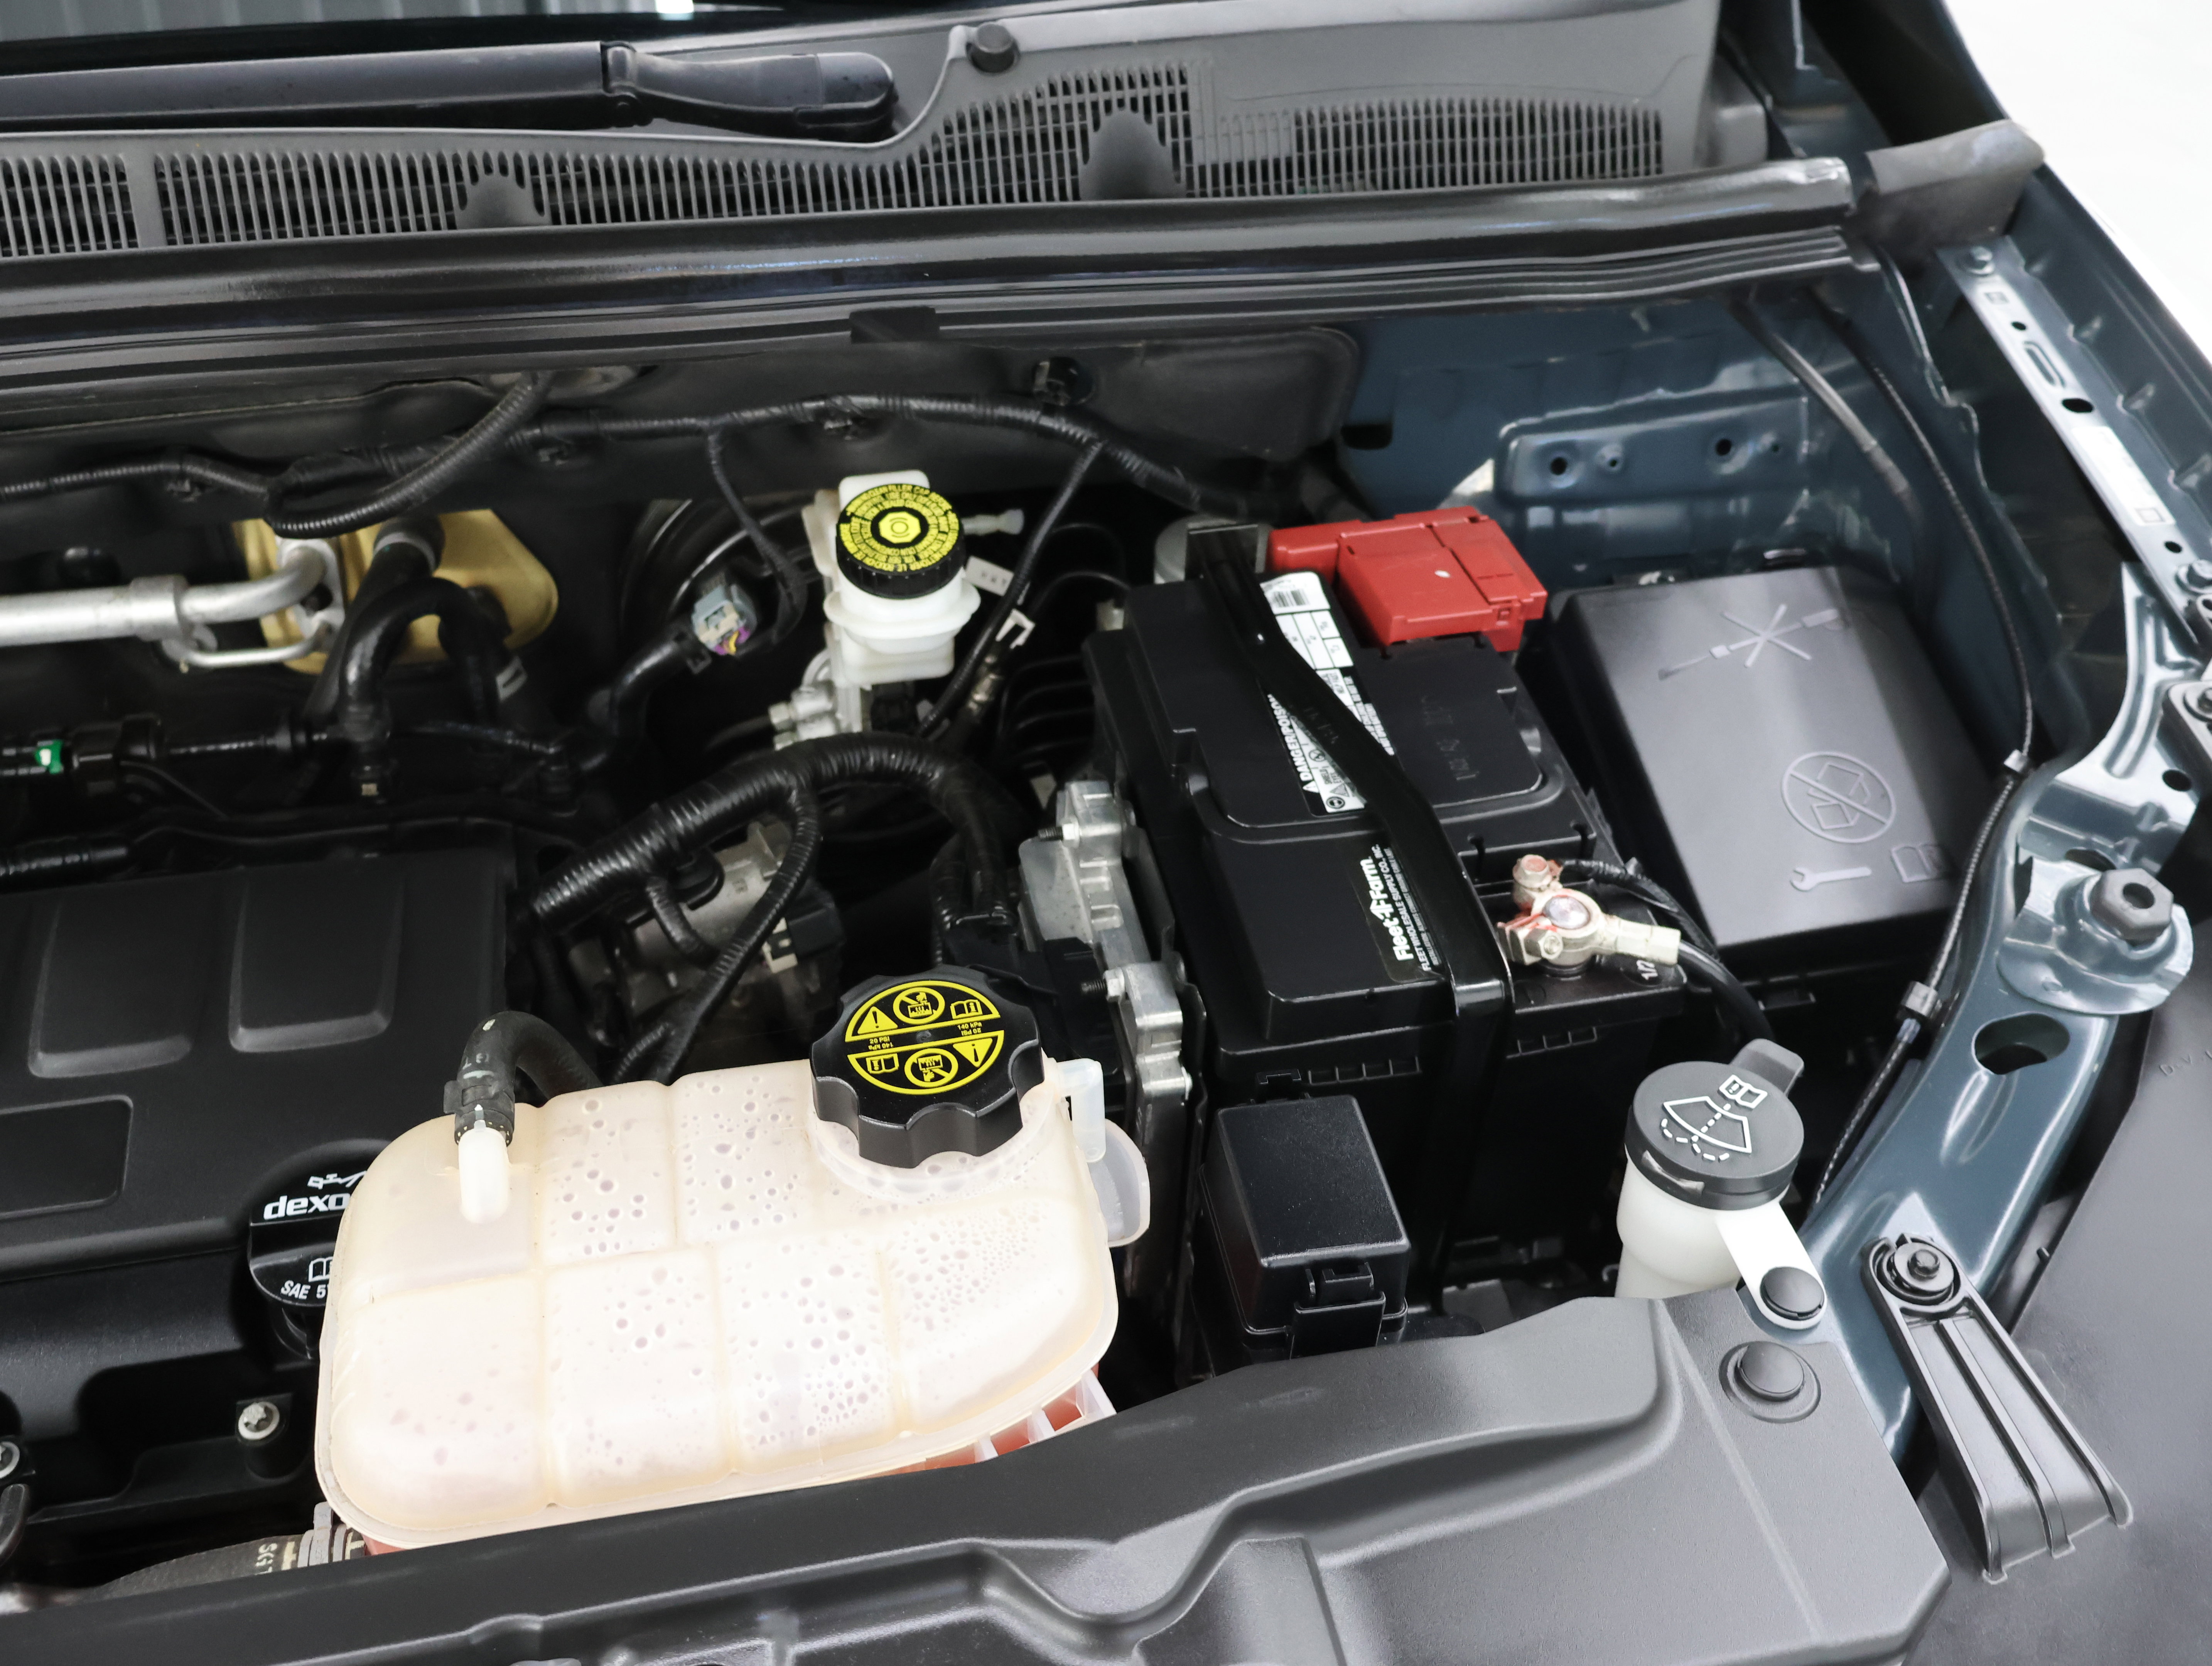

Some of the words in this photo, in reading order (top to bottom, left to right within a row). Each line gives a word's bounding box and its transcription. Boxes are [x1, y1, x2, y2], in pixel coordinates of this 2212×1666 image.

[1360, 858, 1388, 899] Farm
[1383, 874, 1402, 901] SUPPLY
[1383, 917, 1414, 961] Fleet
[1395, 900, 1421, 947] WHOLESALE
[1414, 946, 1431, 971] FLEET
[281, 1280, 310, 1299] SAE
[316, 1284, 329, 1298] 5
